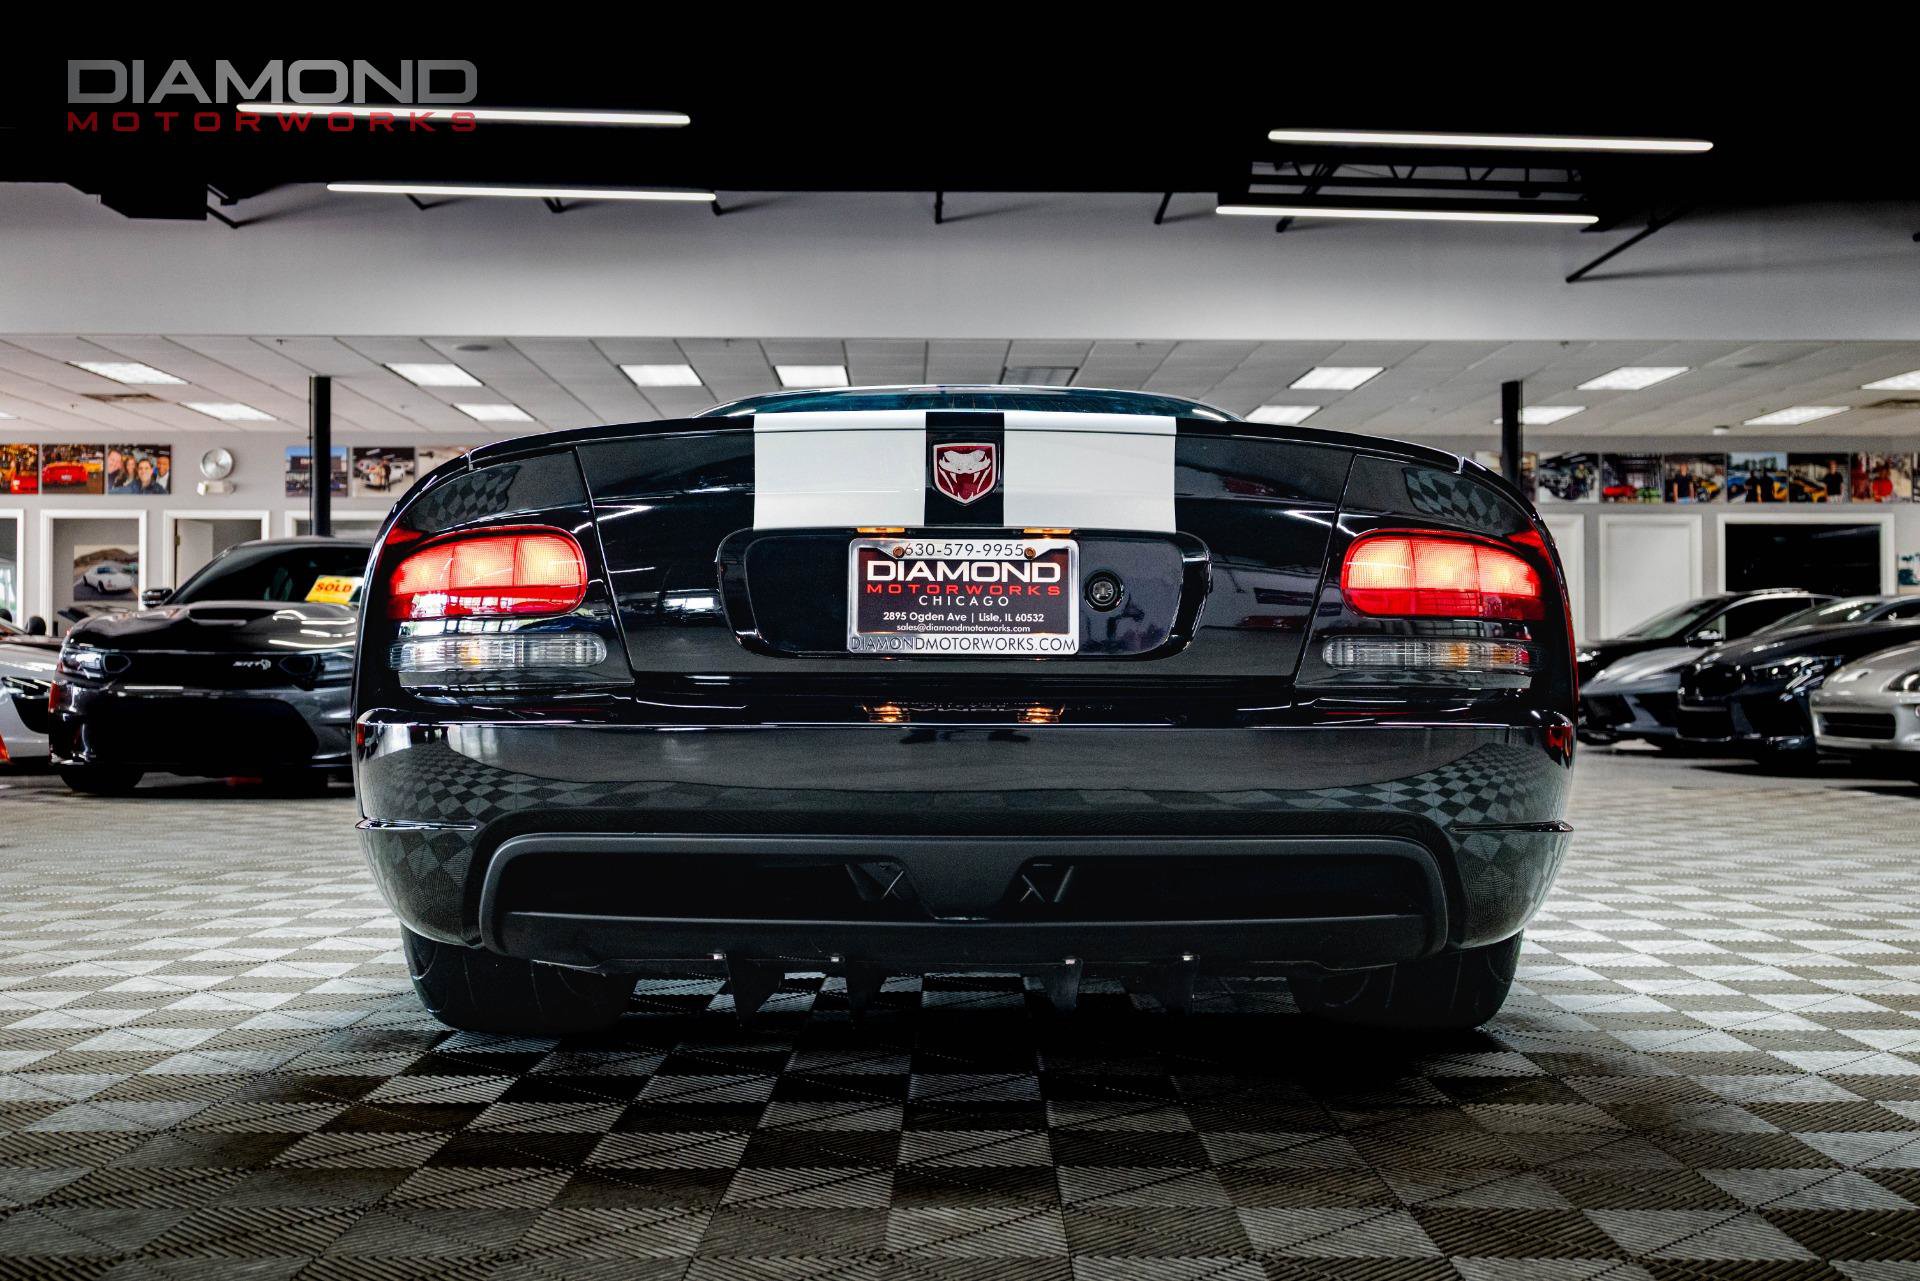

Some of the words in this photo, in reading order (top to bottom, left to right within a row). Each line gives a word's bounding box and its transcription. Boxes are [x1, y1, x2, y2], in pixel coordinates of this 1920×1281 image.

[904, 543, 1024, 557] 630-579-9955
[867, 560, 1061, 583] DIAMOND
[315, 582, 352, 593] SOLD
[866, 584, 1061, 596] MOTORWORKS
[918, 595, 1009, 607] CHICAGO
[883, 611, 907, 621] 2895
[909, 611, 945, 623] Ogden
[947, 612, 967, 622] Ave
[978, 612, 1002, 623] Lisle,
[1004, 613, 1013, 622] IL
[1015, 613, 1045, 623] 60532
[896, 622, 1031, 633] sales@diamondmotorworks.com
[851, 636, 1076, 651] DIAMONDMOTORWORKS.COM
